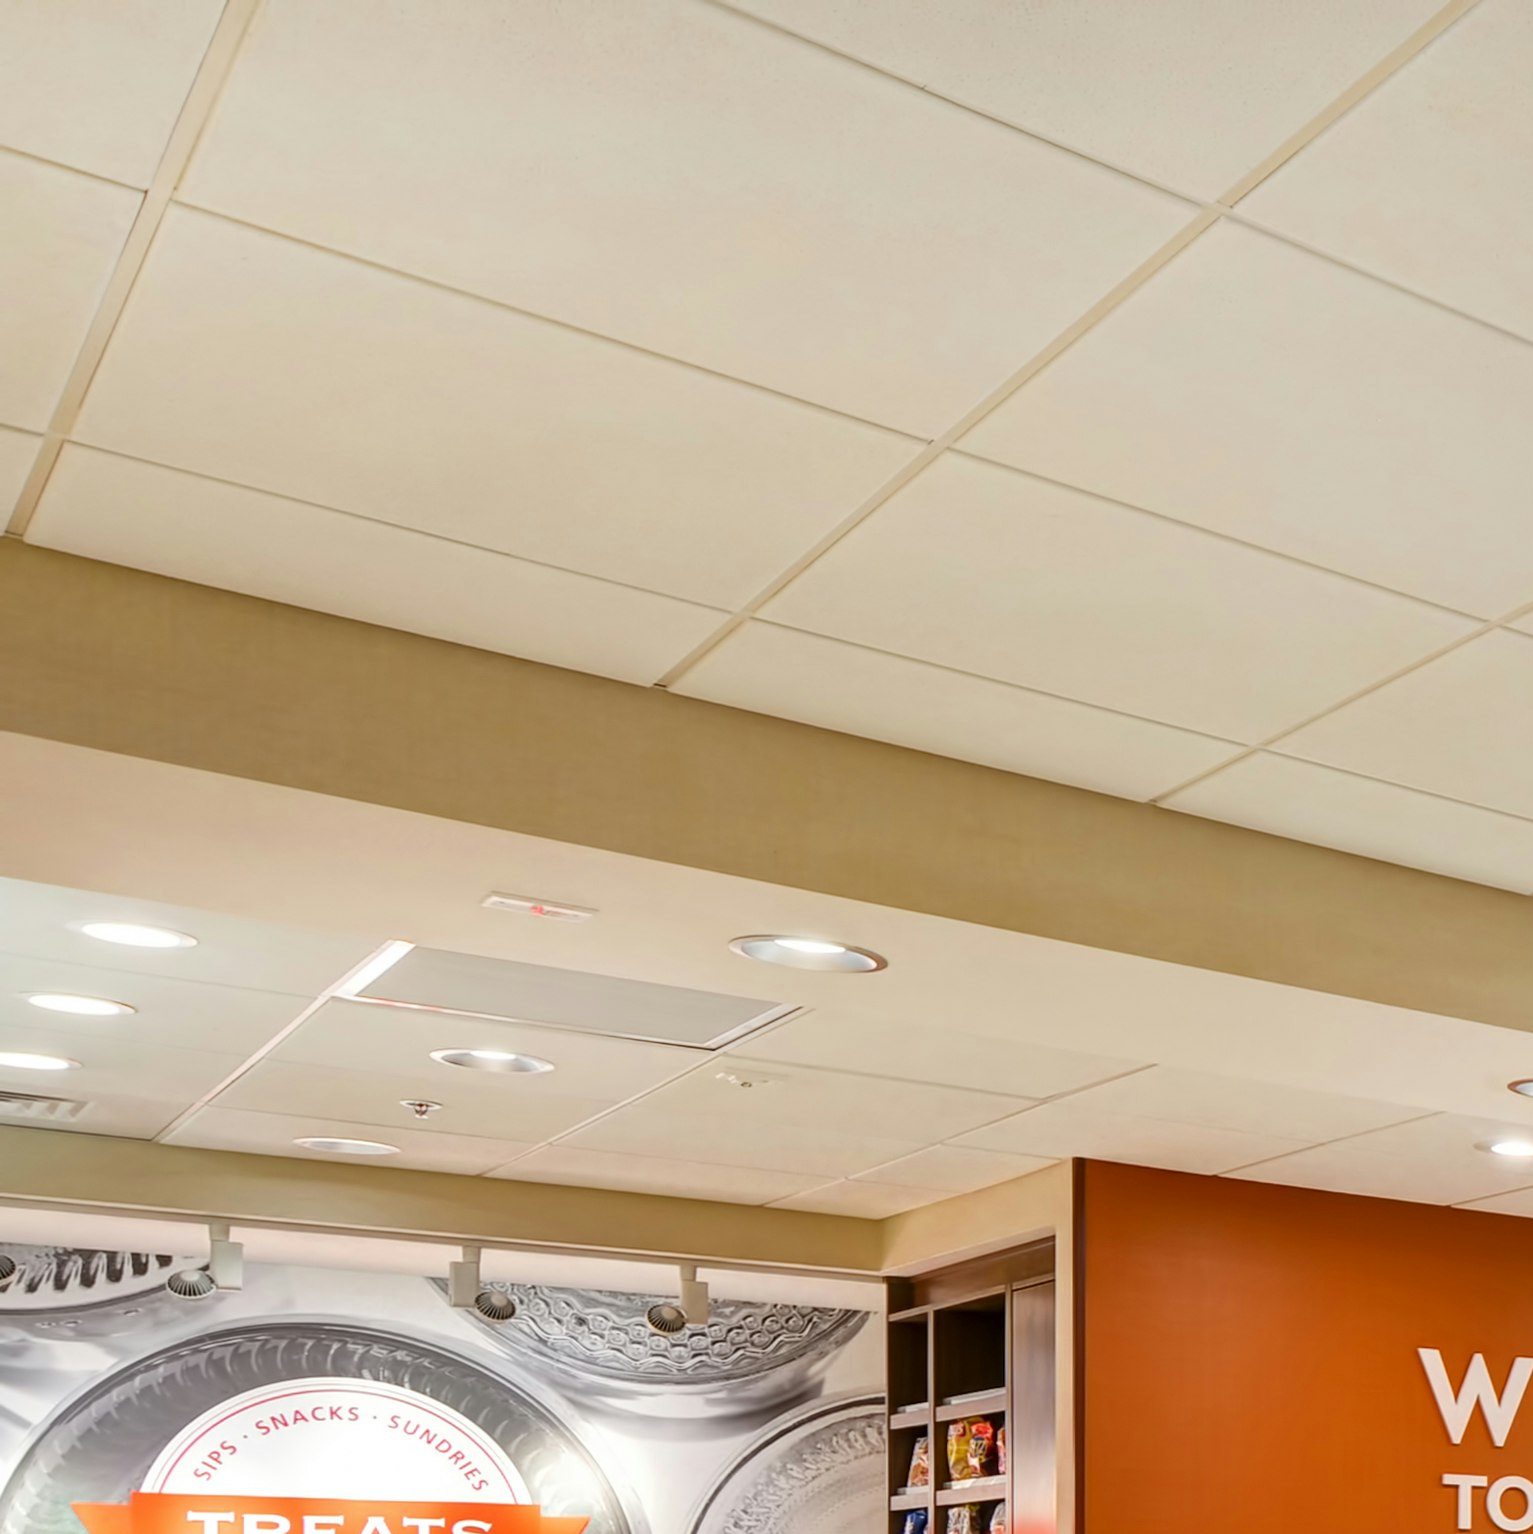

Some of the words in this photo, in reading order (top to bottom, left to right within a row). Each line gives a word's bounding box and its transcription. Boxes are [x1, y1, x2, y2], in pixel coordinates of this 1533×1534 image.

[193, 1440, 237, 1481] SIPS
[255, 1406, 360, 1436] SNACKS
[388, 1415, 489, 1492] SUNDRIES
